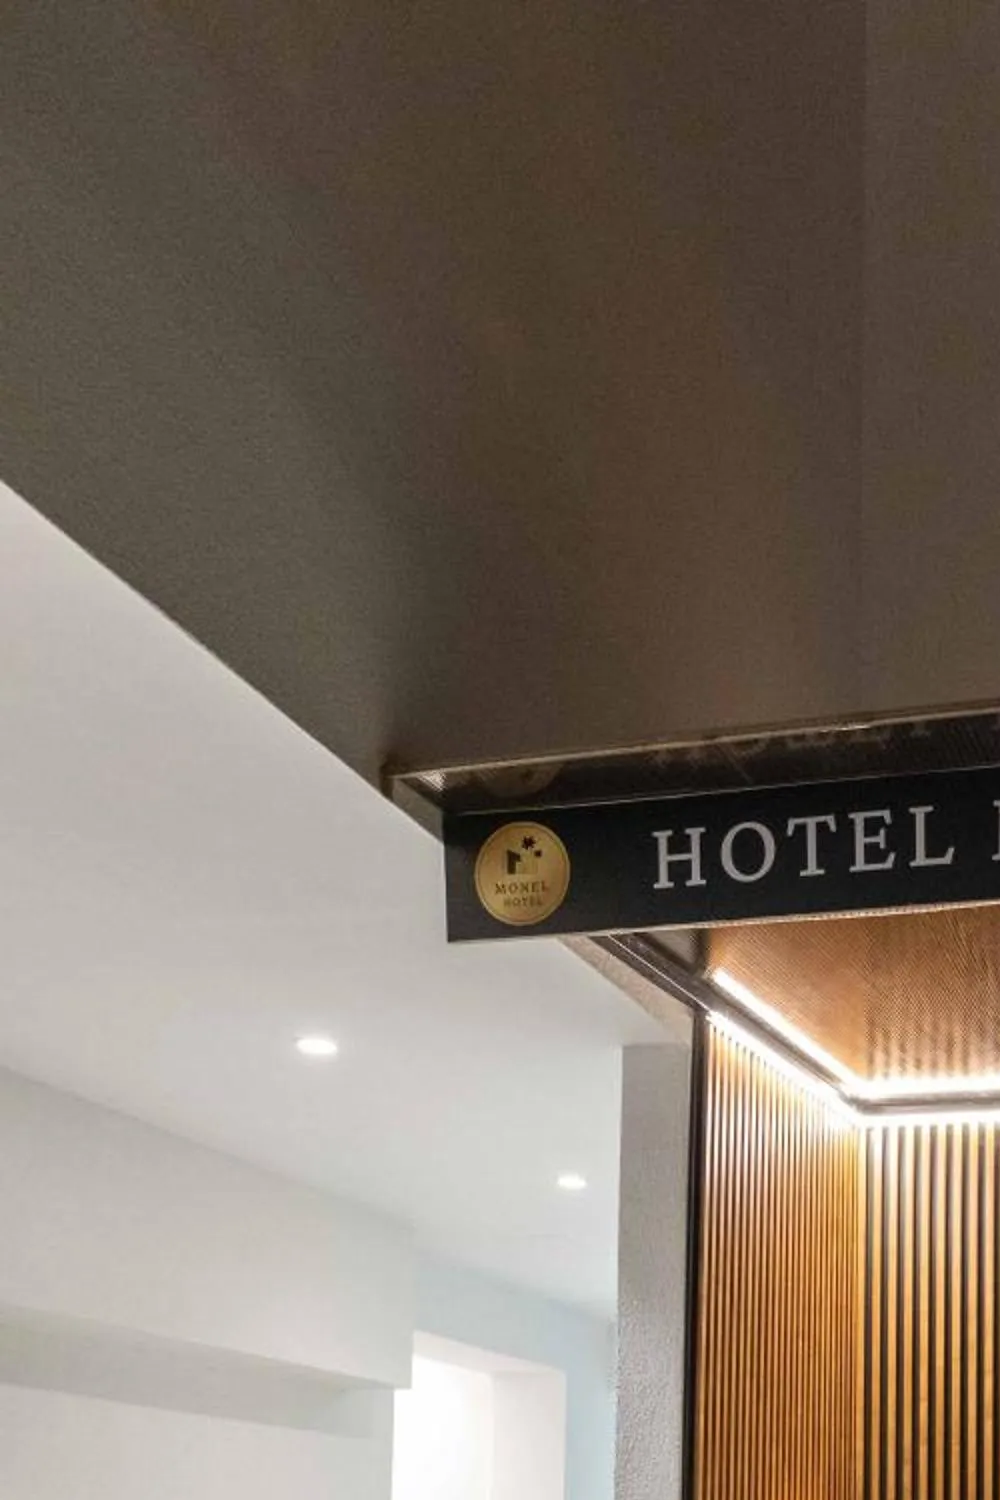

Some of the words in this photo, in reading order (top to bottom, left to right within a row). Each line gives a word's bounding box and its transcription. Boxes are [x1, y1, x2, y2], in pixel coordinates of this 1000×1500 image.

[652, 805, 955, 889] HOTEL
[494, 880, 549, 895] MONEL
[503, 895, 543, 907] HOTEL
